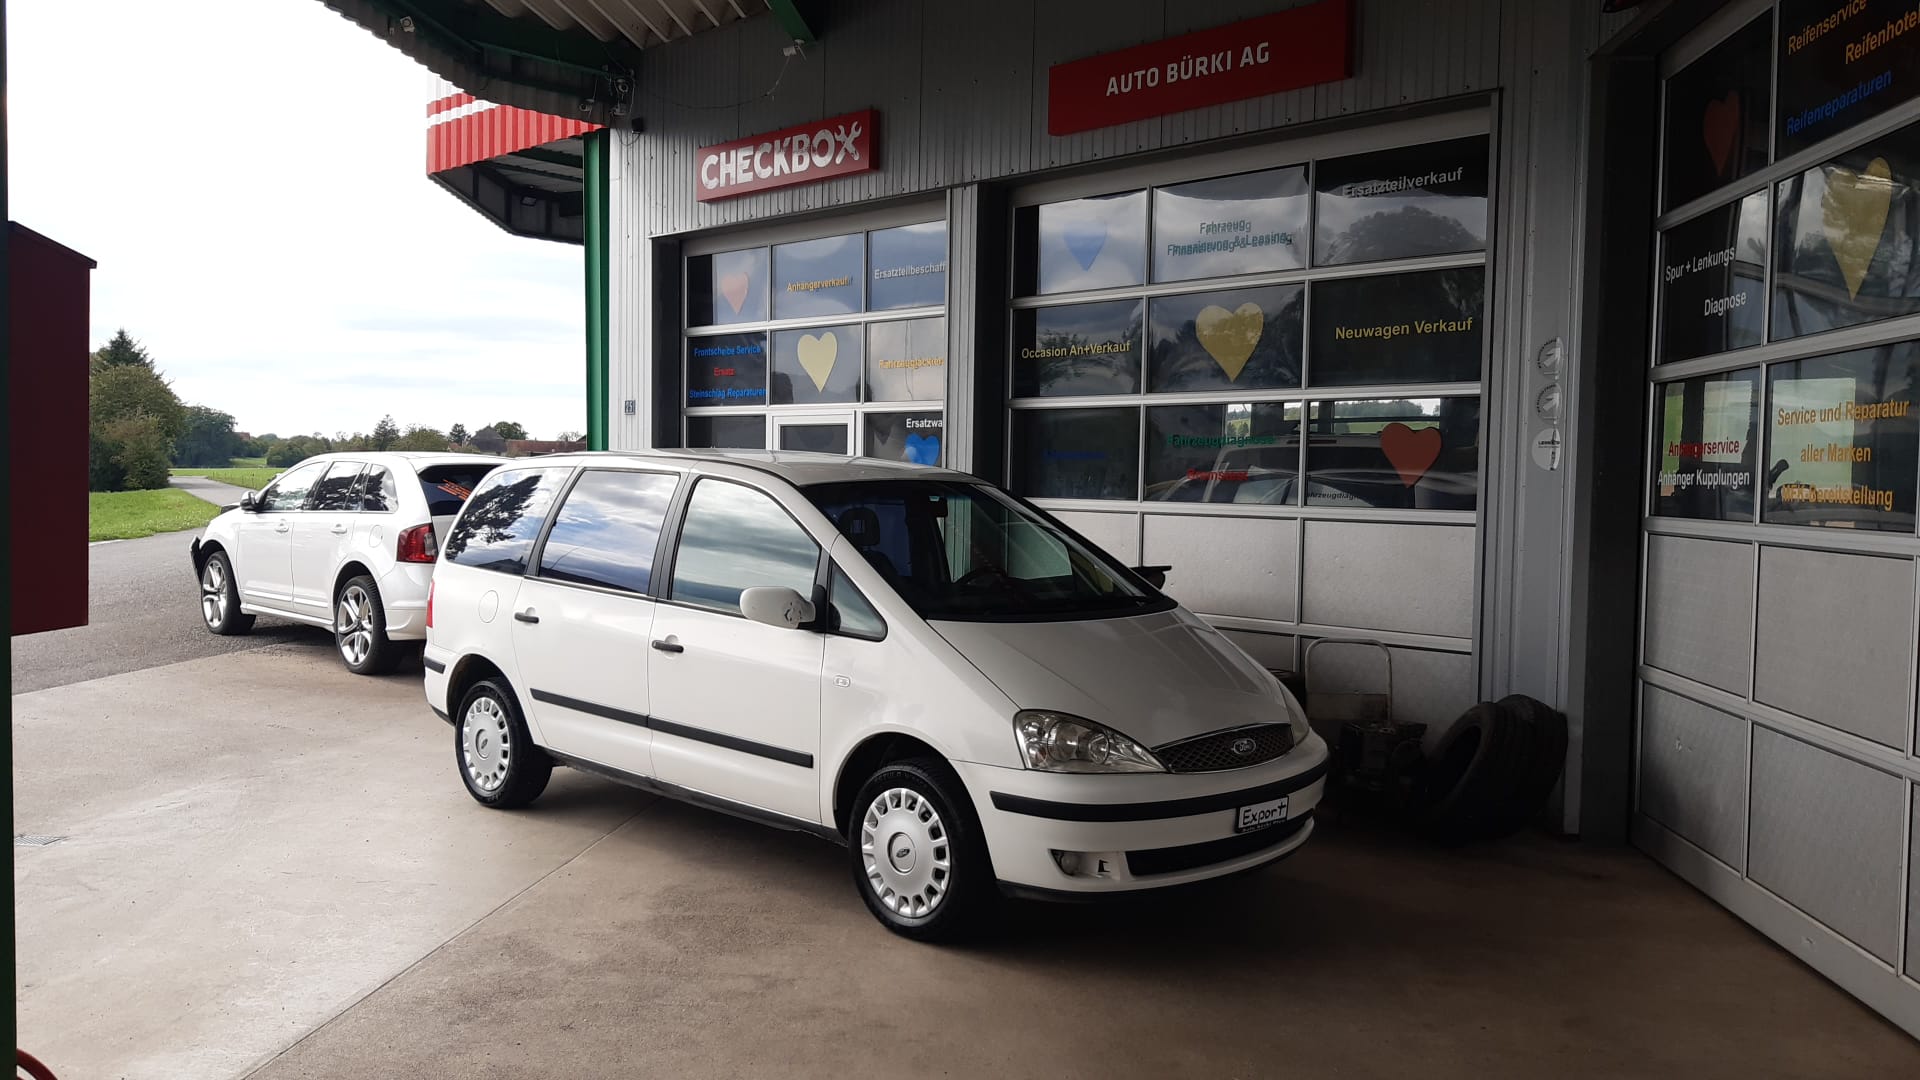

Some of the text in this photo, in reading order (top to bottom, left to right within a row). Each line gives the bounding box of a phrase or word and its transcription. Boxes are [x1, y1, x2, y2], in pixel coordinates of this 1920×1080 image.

[1788, 0, 1867, 55] Reifenservice
[1106, 42, 1270, 96] AUTO BÜRKI AG
[1787, 69, 1892, 136] Reifenreparaturen
[701, 121, 862, 190] CHECKBOX
[1342, 167, 1463, 197] Ersatzteilverkauf
[1665, 247, 1735, 284] Spur + Lenkungs
[1704, 292, 1747, 316] Diagnose
[1335, 317, 1473, 340] Neuwagen Verkauf
[736, 344, 762, 355] Service
[1021, 341, 1131, 359] Occasion An+Verkauf
[1777, 398, 1910, 426] Service und Reparatur
[1801, 443, 1872, 463] aller Marken
[1657, 468, 1750, 491] Anhänger Kupplungen
[1242, 801, 1287, 827] Export
